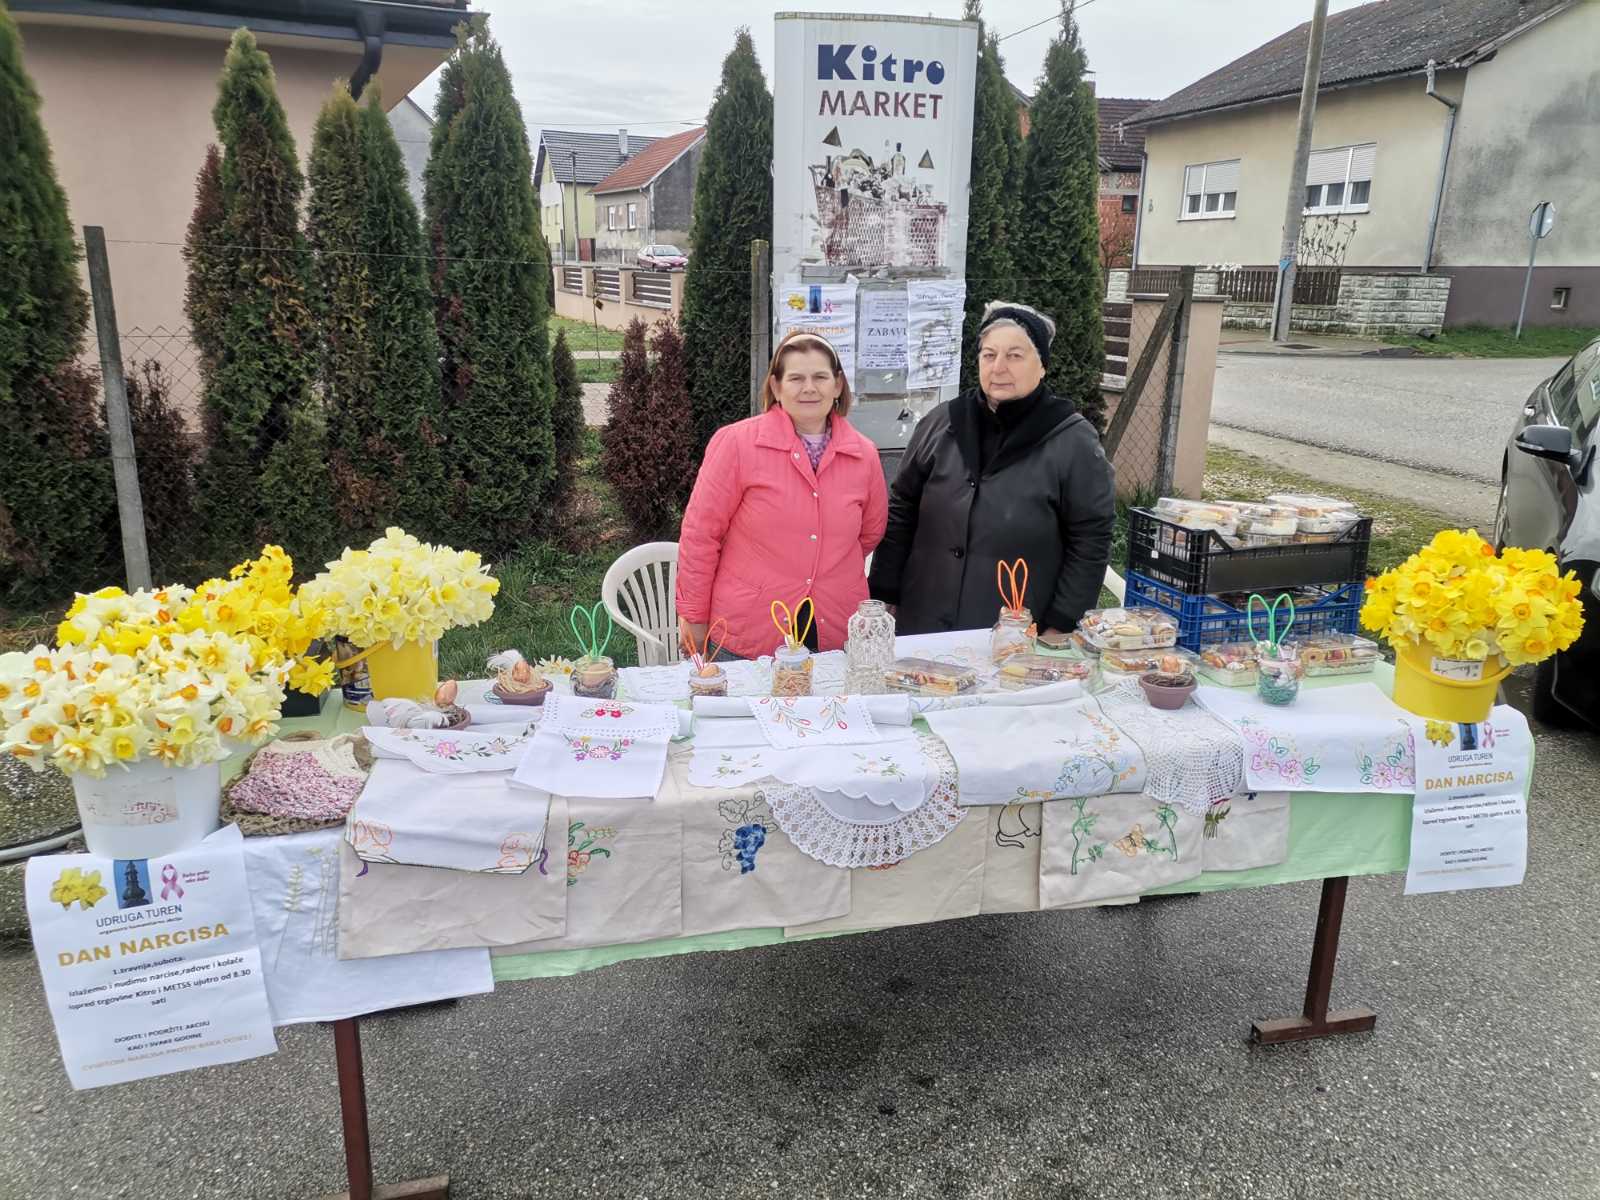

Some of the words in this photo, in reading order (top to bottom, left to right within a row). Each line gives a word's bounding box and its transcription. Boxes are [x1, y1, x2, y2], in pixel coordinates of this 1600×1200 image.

[817, 44, 945, 85] Kitro
[818, 89, 943, 119] MARKET
[1424, 777, 1453, 790] DAN
[1456, 770, 1514, 787] NARCISA
[96, 911, 143, 928] UDRUGA
[145, 904, 183, 919] TUREN
[58, 945, 111, 967] DAN
[119, 922, 229, 956] NARCISA
[220, 972, 232, 981] od
